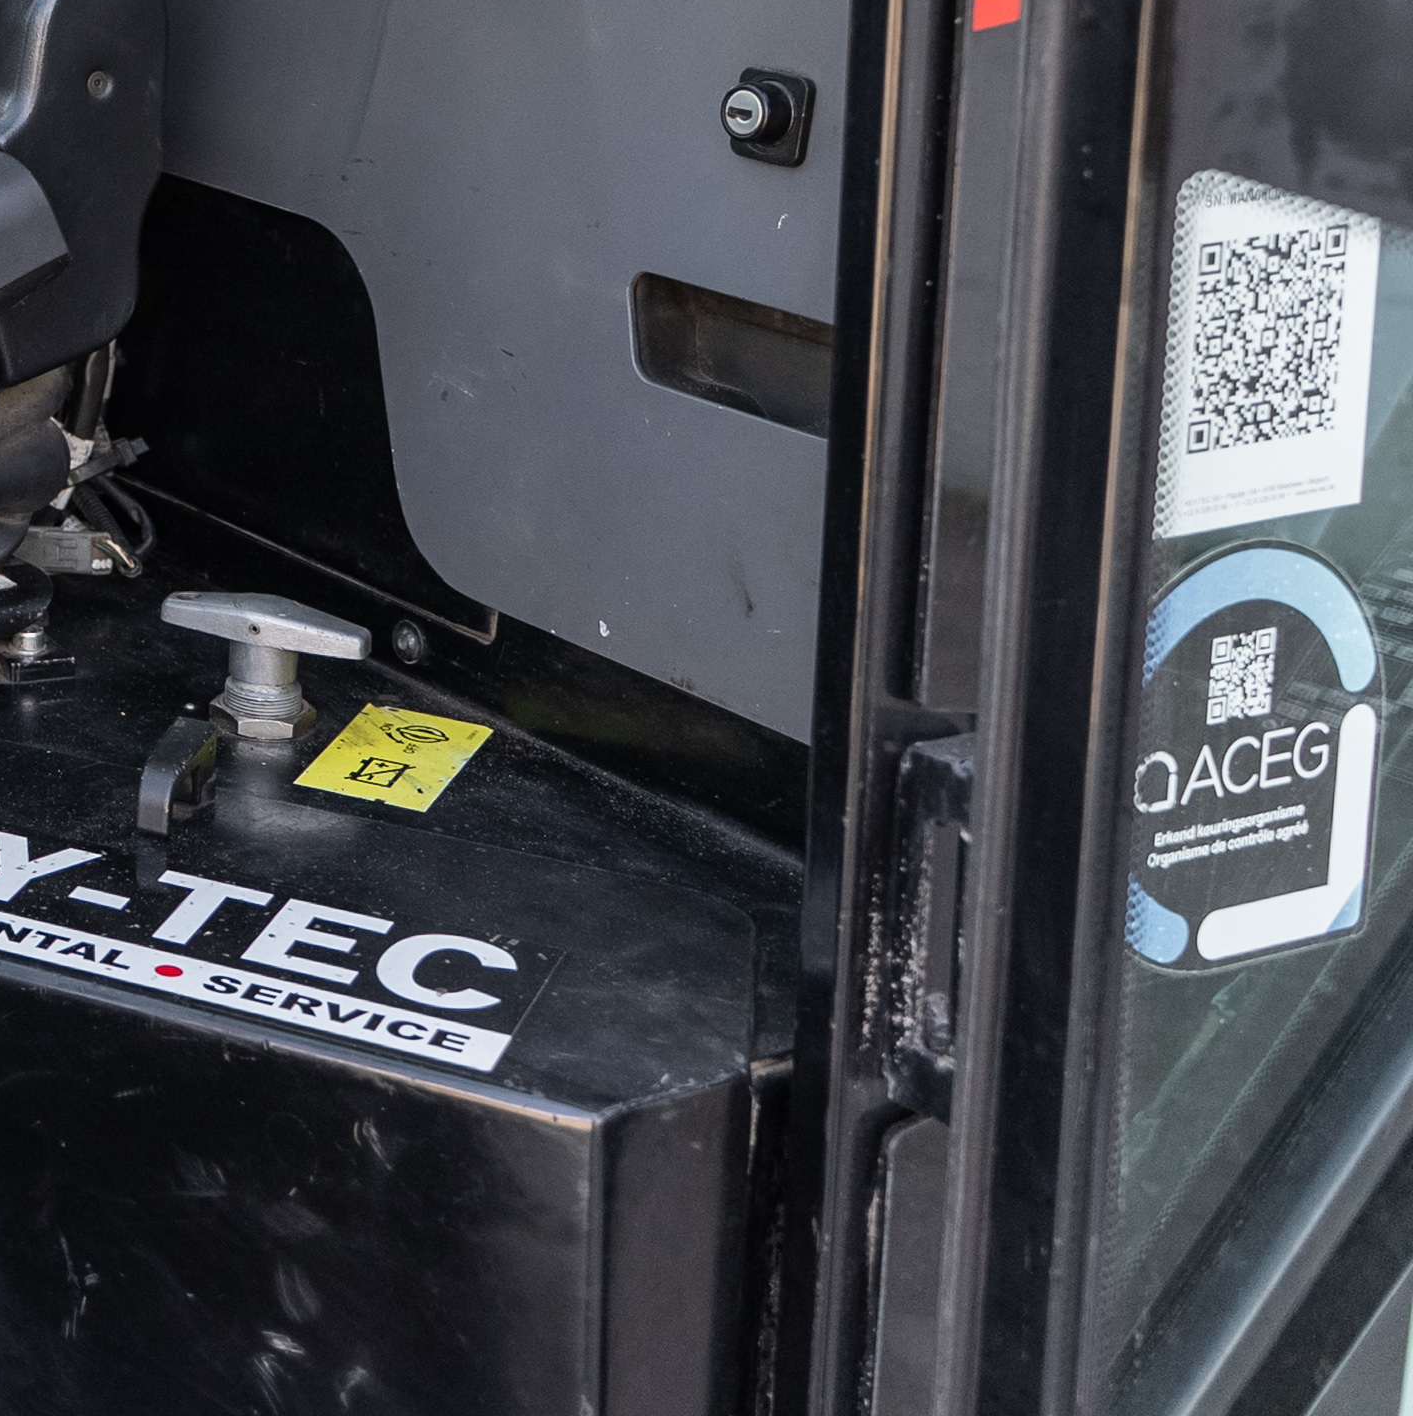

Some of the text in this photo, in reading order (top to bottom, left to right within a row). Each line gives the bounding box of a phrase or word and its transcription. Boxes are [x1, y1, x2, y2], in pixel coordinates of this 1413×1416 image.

[1180, 721, 1331, 806] ACEG
[1146, 843, 1211, 869] Organisme
[1210, 839, 1227, 855] de
[1153, 804, 1306, 847] Erkend keuringsorganisme
[202, 974, 471, 1054] SERVICE
